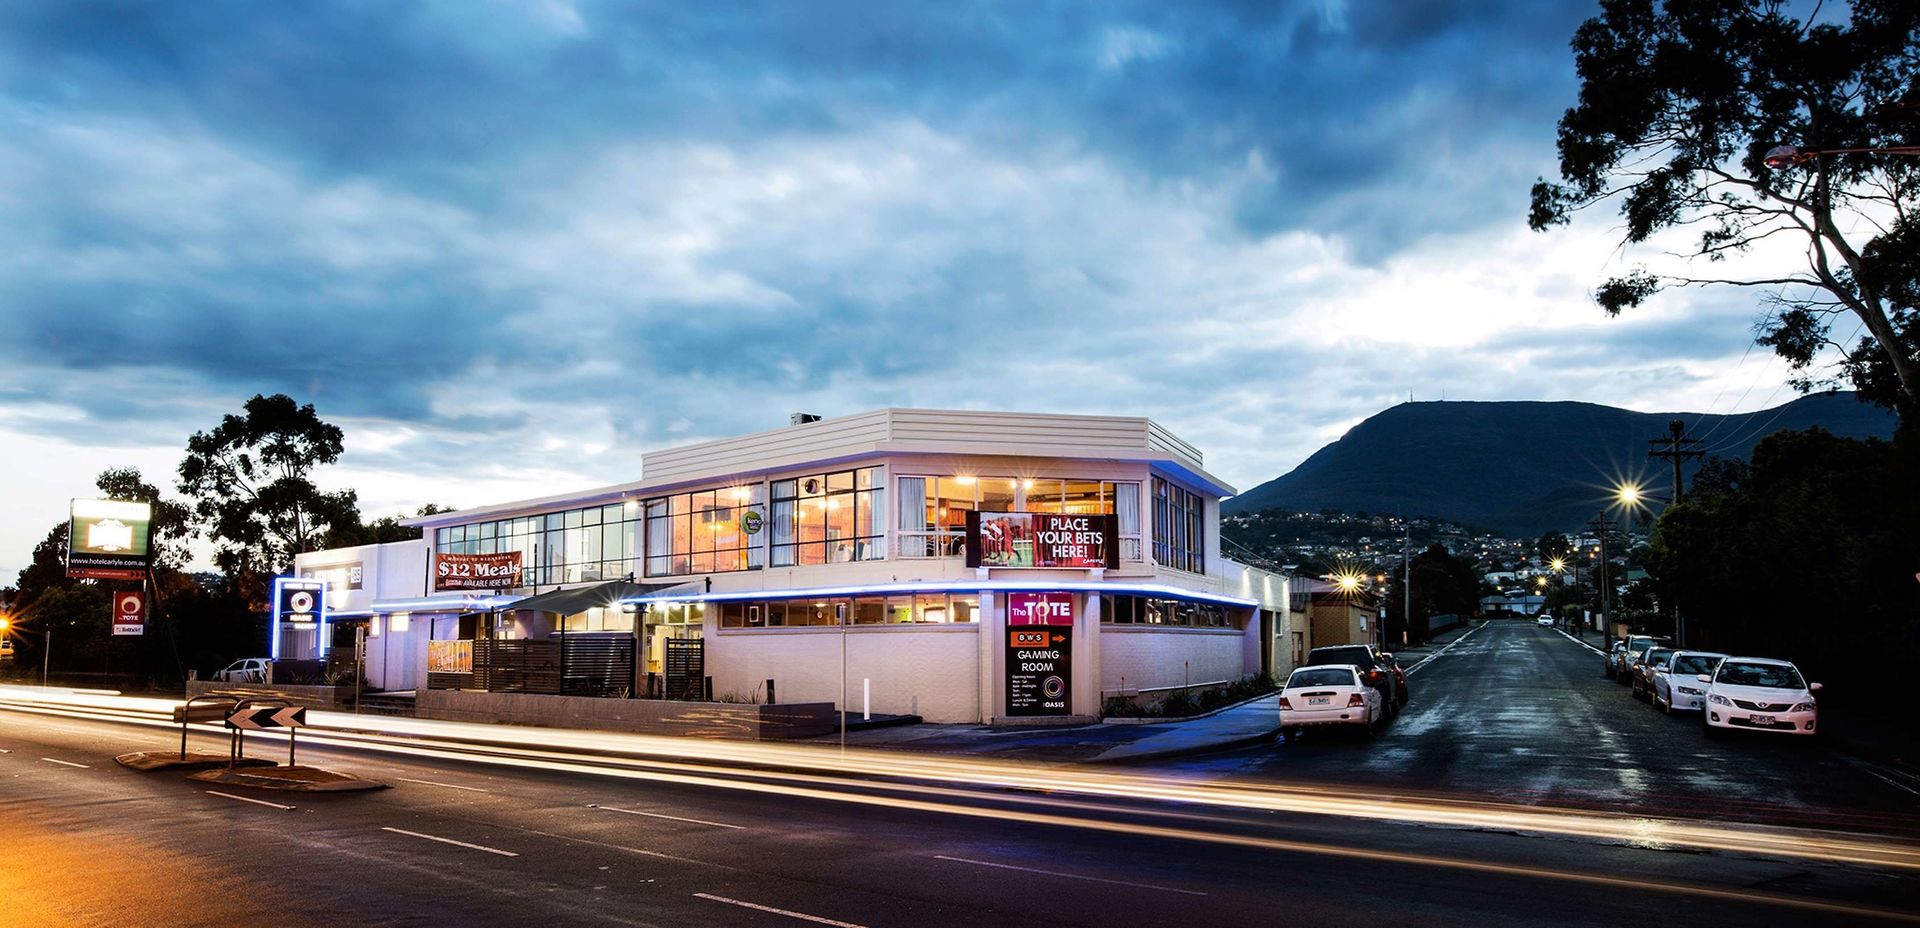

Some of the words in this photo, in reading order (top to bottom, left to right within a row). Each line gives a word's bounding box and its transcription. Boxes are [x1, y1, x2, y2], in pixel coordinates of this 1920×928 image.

[1051, 518, 1089, 531] PLACE
[1036, 531, 1073, 544] YOUR
[1076, 531, 1103, 545] BETS
[1052, 545, 1088, 558] HERE!
[70, 558, 146, 567] www.hotelcarlyle.com.au
[438, 561, 471, 577] $12
[474, 560, 520, 577] Meals
[463, 579, 489, 587] AVAILABLE
[489, 578, 501, 587] HERE
[1012, 608, 1027, 616] The
[1024, 601, 1071, 617] TOTE
[1017, 650, 1060, 660] GAMING
[1021, 662, 1054, 672] ROOM
